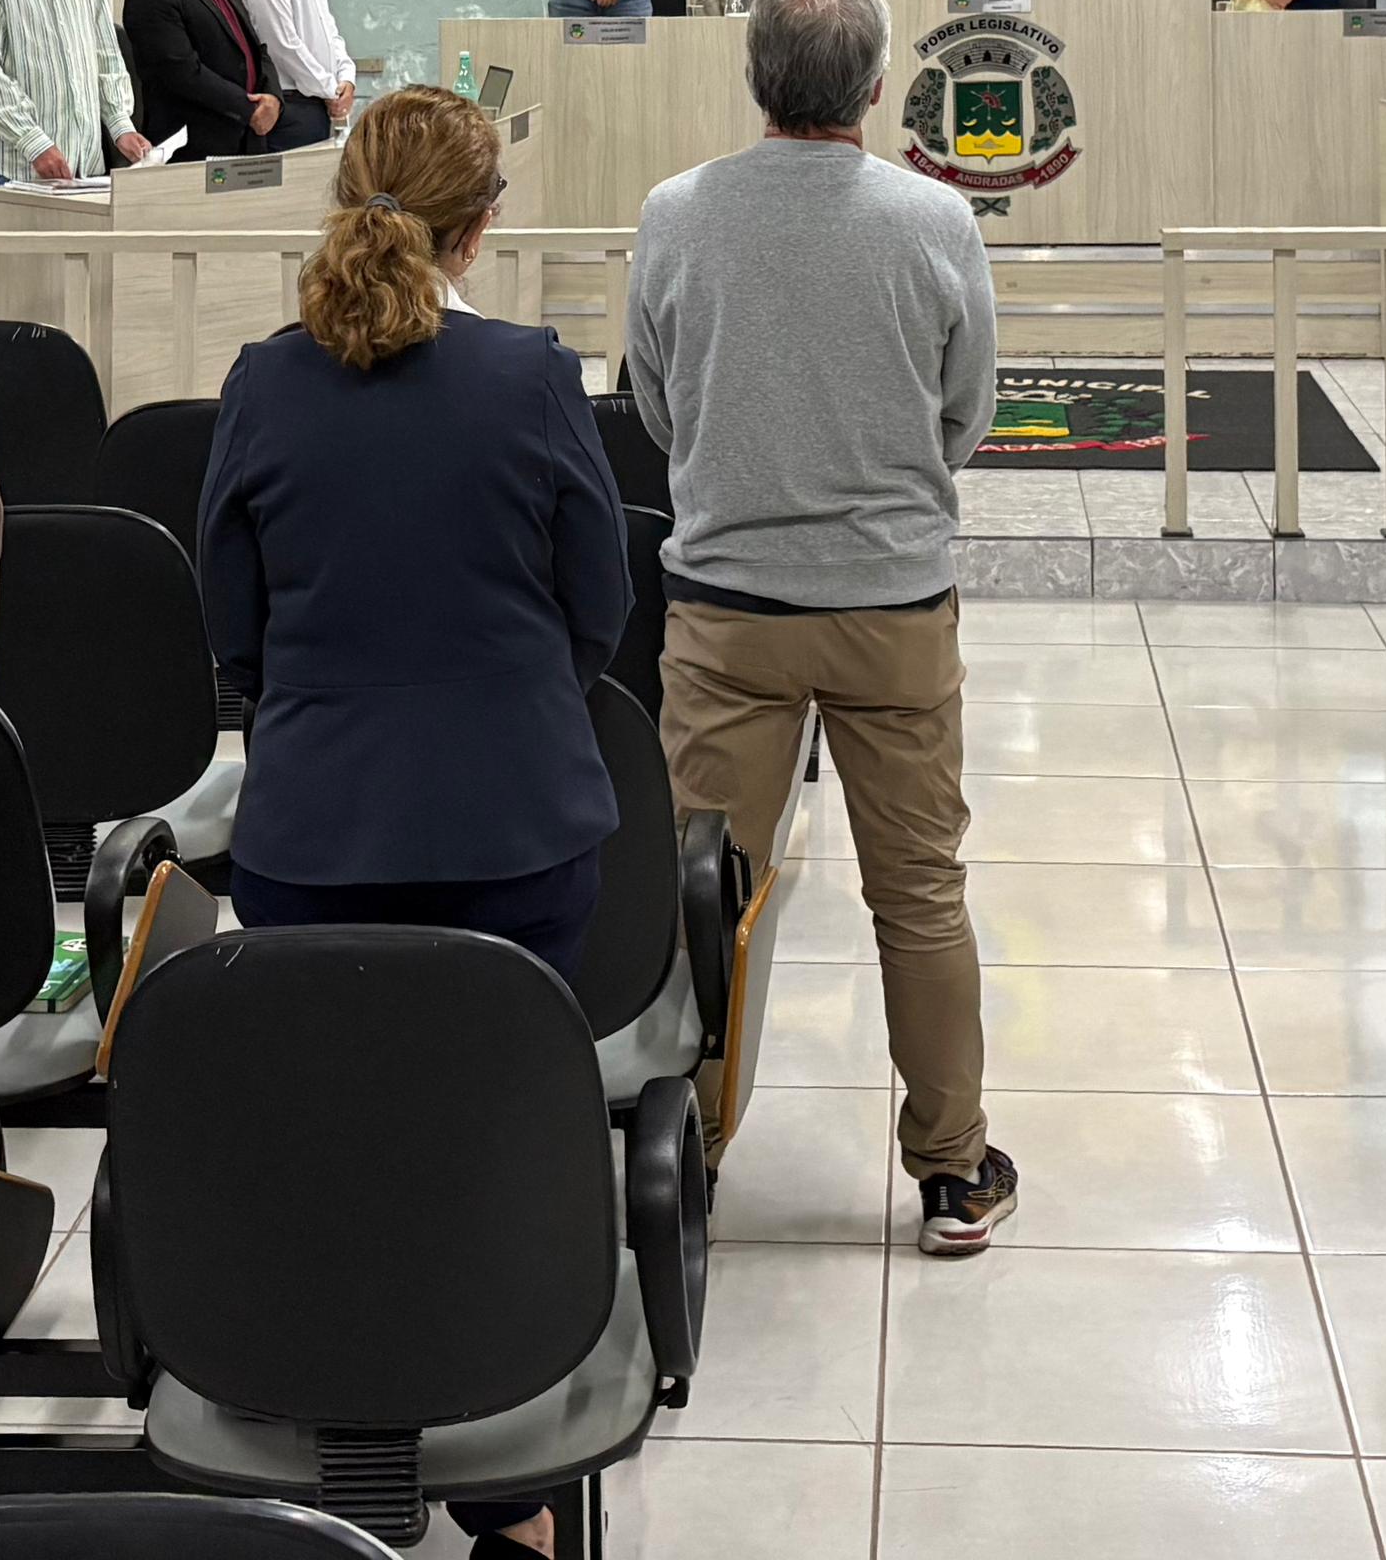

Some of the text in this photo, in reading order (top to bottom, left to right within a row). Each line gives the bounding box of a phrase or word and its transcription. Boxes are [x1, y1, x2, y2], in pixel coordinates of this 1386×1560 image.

[920, 18, 1060, 54] PODER LEGISLATIVO
[956, 172, 1025, 186] ANDRADAS
[1040, 153, 1070, 180] 1890
[997, 378, 1212, 399] UNICIPL
